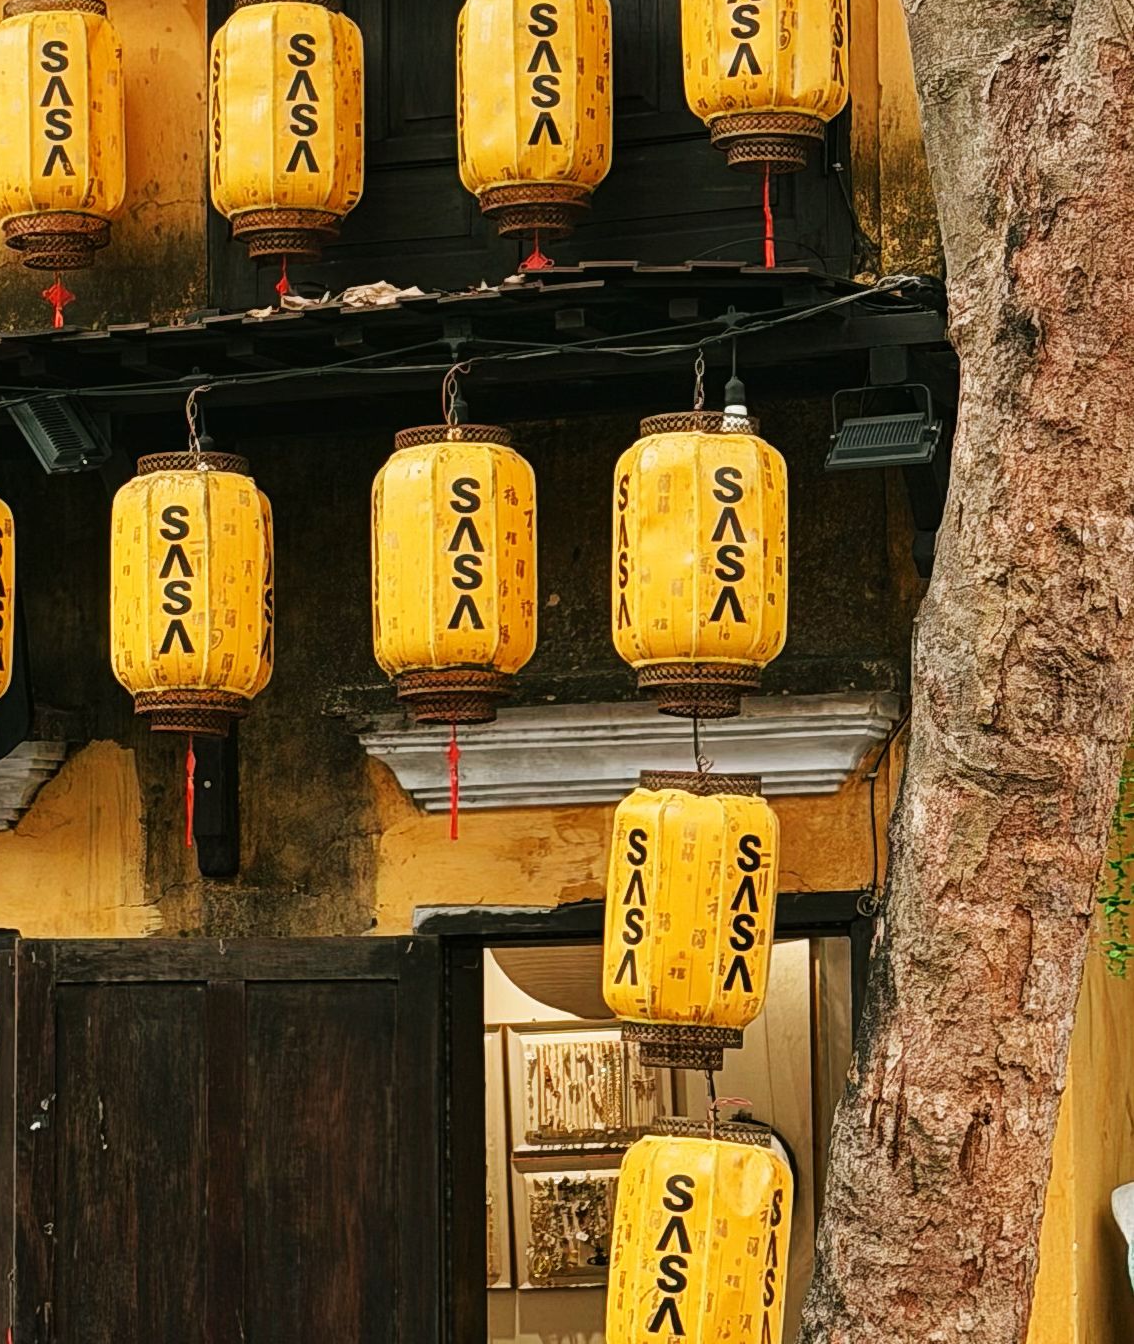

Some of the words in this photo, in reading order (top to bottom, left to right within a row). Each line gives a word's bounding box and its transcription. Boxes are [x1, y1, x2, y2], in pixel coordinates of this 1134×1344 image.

[40, 40, 74, 177] SASA
[285, 33, 321, 173] SASA
[527, 3, 563, 146] SASA
[159, 505, 195, 655] SASA
[447, 477, 485, 630] SASA
[617, 474, 632, 630] SASA
[709, 466, 747, 623] SASA
[615, 829, 647, 986] SASA
[723, 834, 762, 993] SASA
[648, 1174, 696, 1337] SASA
